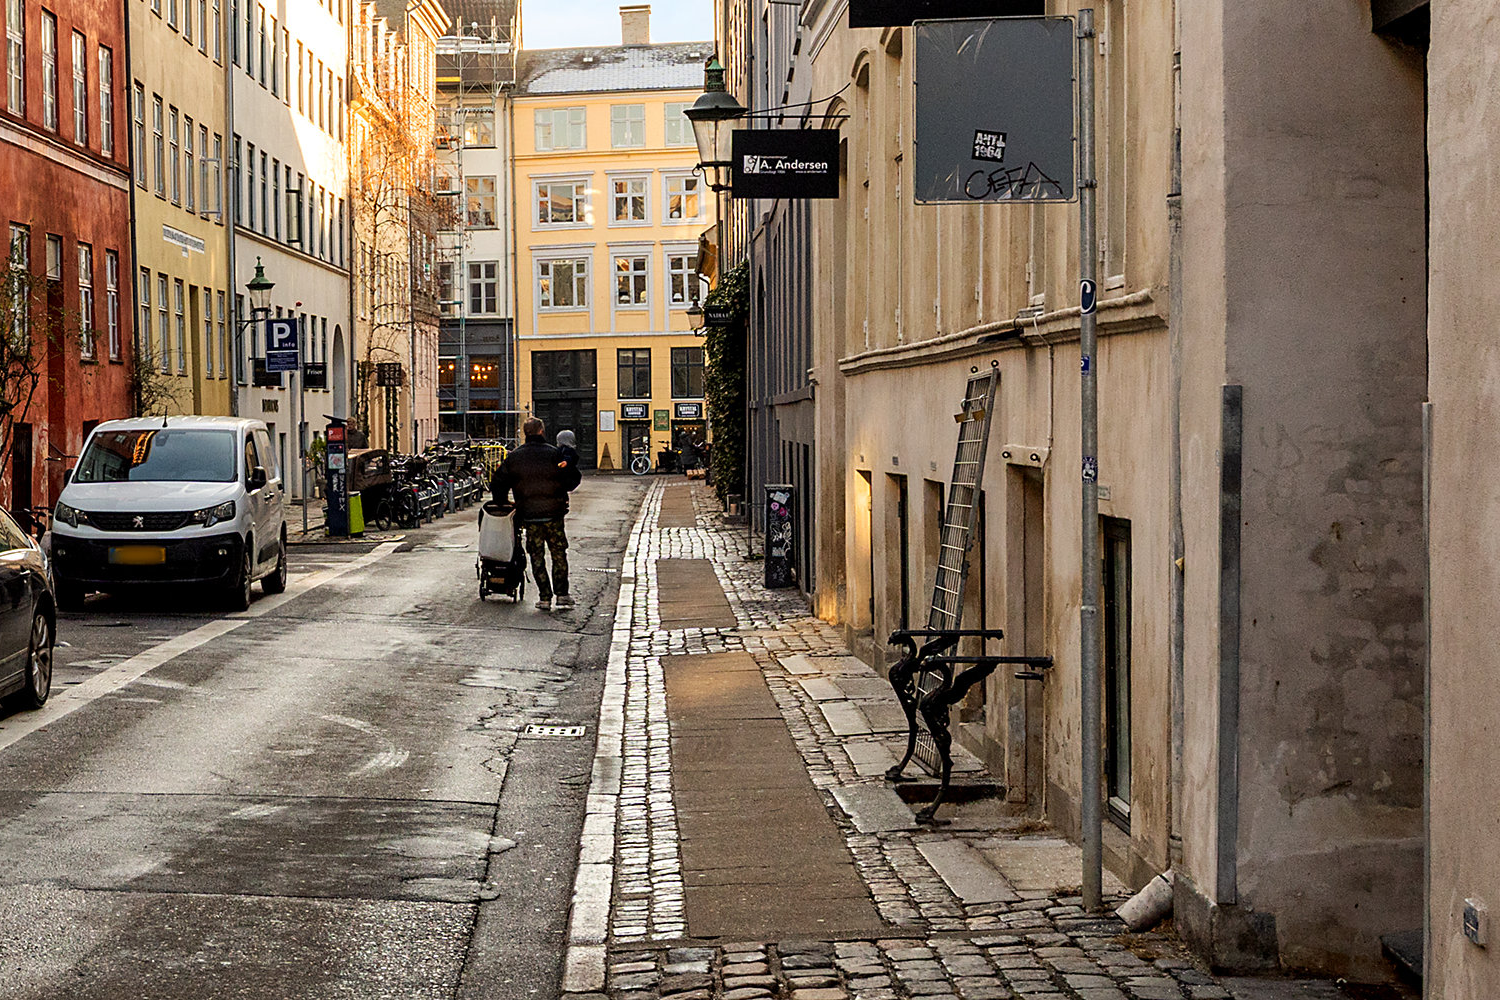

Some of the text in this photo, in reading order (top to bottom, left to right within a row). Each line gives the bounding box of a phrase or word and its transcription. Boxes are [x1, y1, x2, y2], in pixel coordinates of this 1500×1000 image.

[760, 159, 828, 169] A. Andersen
[273, 322, 291, 348] P
